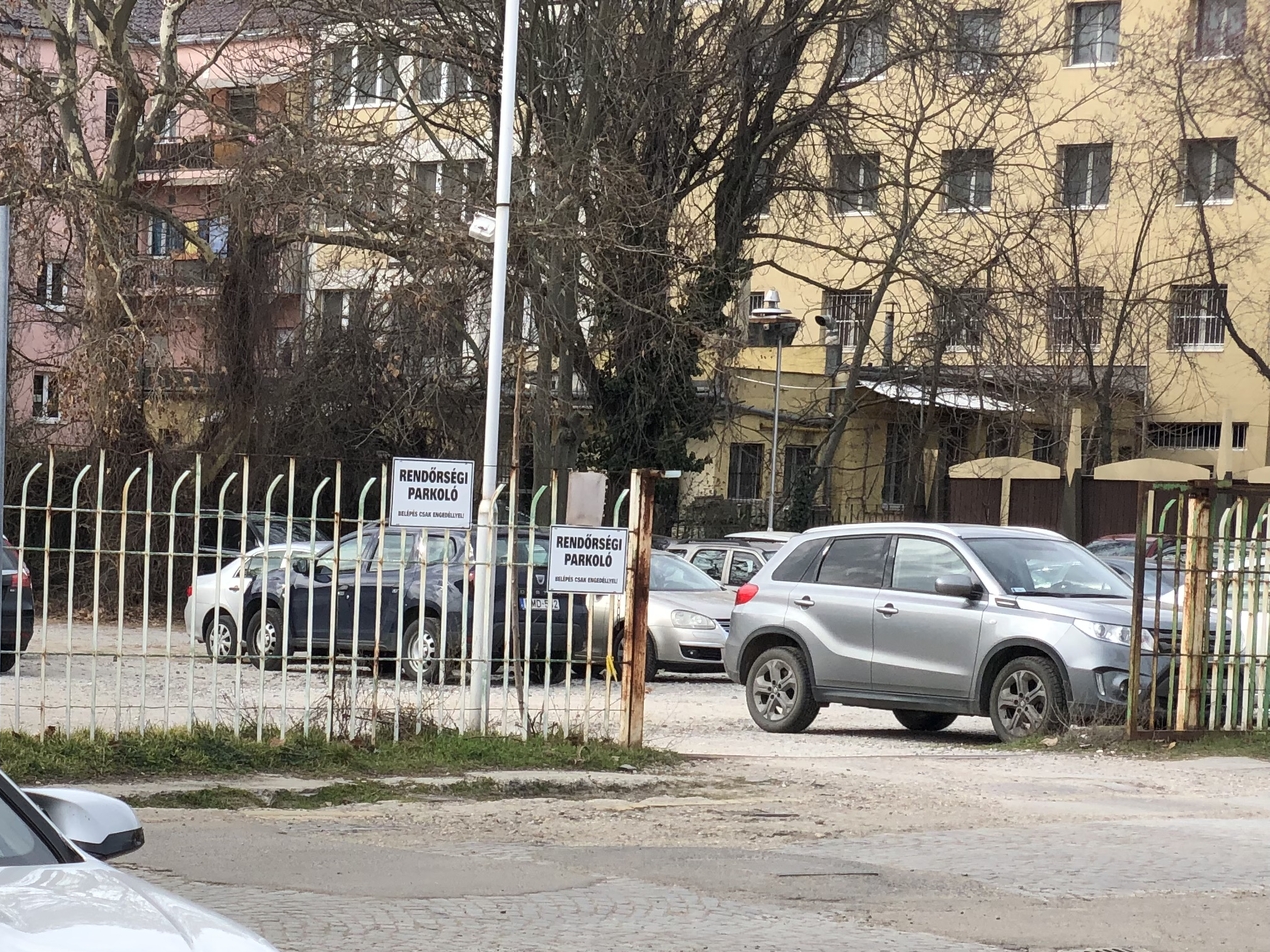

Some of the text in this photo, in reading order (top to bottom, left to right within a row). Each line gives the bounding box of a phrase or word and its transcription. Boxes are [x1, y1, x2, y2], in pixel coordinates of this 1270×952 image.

[399, 466, 468, 485] RENDŐRSÉGI
[407, 485, 459, 502] PARKOLÓ
[397, 510, 418, 518] BELÉPÉS
[556, 533, 623, 551] RENDŐRSÉGI
[564, 551, 613, 568] PARKOLÓ
